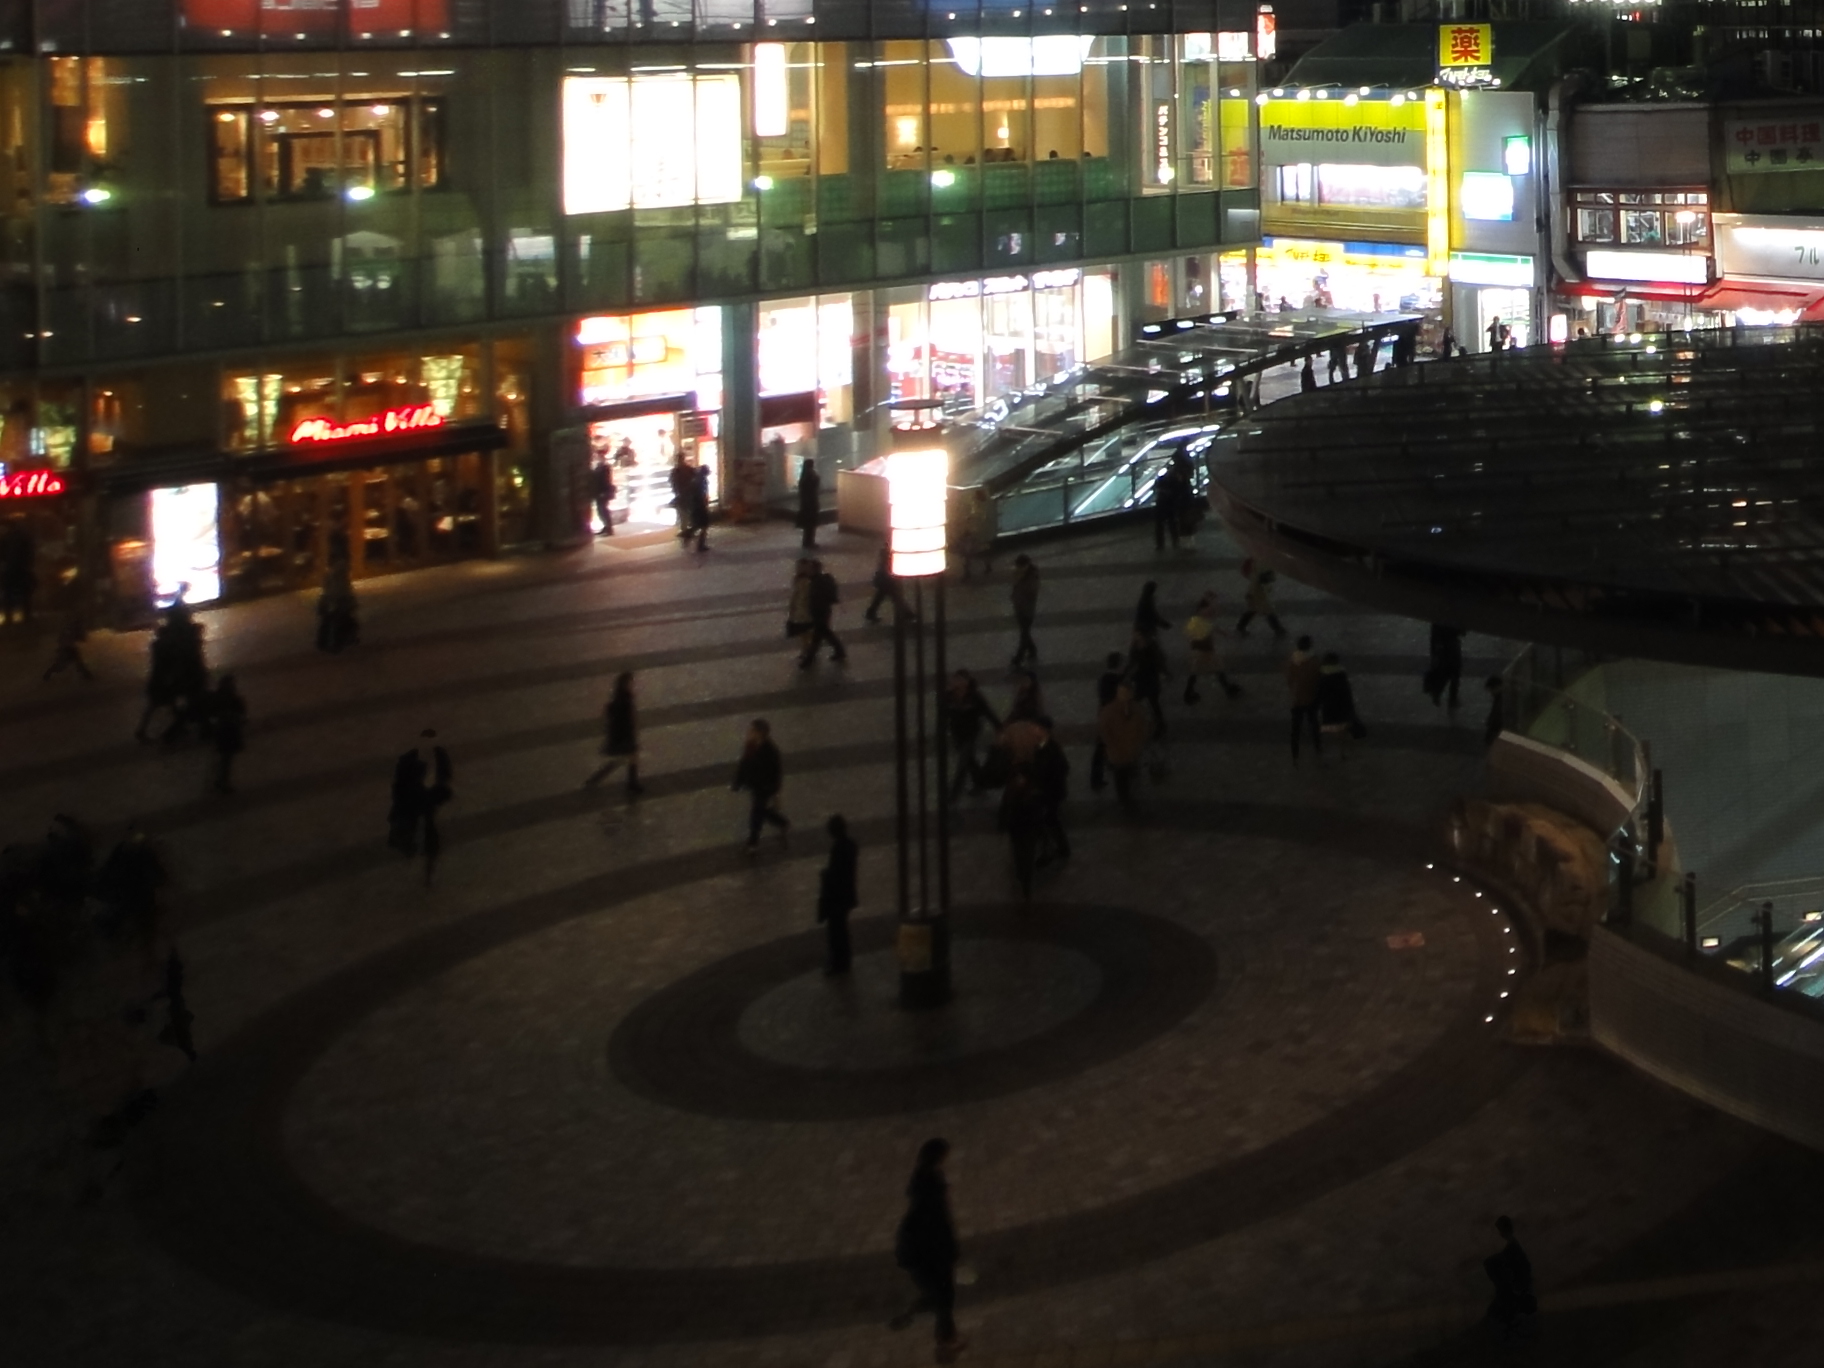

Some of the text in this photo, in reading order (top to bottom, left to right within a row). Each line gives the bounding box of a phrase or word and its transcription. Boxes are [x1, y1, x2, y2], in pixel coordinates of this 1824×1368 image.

[1450, 27, 1481, 63] 薬
[1267, 124, 1407, 144] Matsumoto KiYoshi
[291, 405, 441, 442] Miami Villa
[0, 470, 61, 496] Villa
